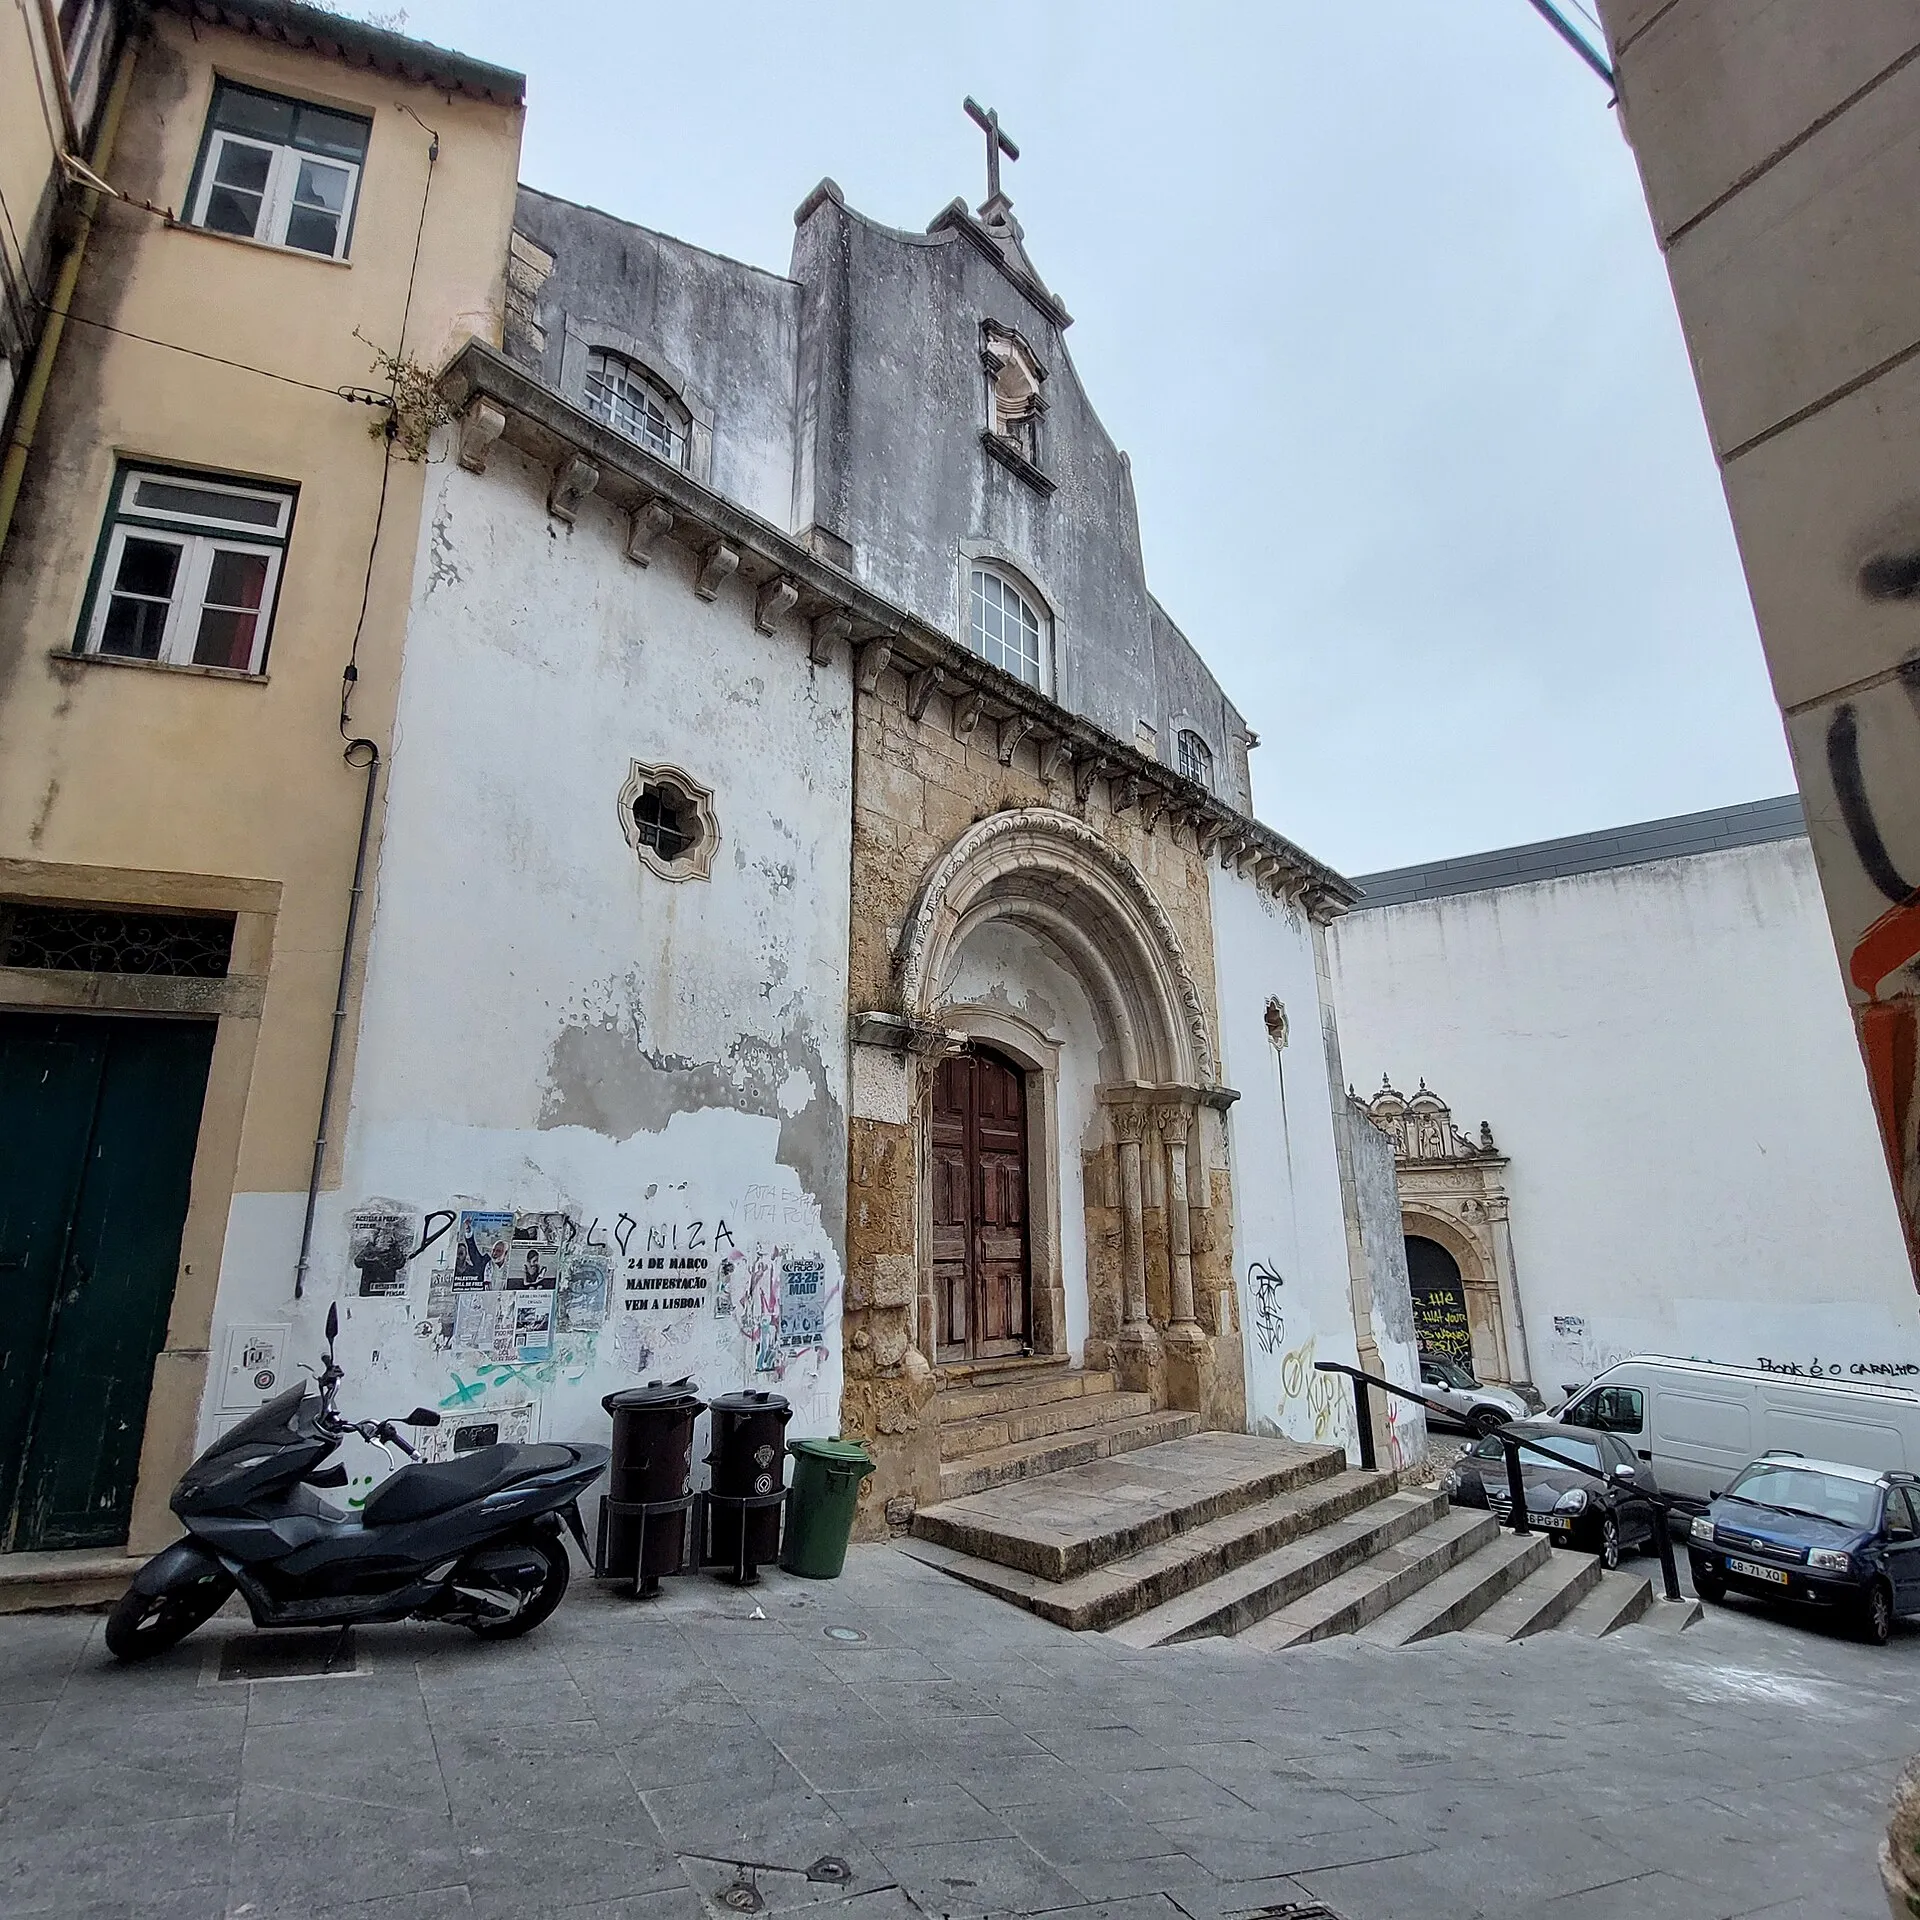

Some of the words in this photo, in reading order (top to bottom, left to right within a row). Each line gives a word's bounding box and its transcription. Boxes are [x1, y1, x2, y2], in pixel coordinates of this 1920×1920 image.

[627, 1258, 643, 1269] 24
[647, 1258, 664, 1269] DE
[669, 1257, 708, 1272] MARÇO
[788, 1272, 818, 1283] 23-26
[789, 1283, 816, 1295] MAIO
[625, 1299, 648, 1310] VEM
[651, 1299, 659, 1309] A
[662, 1297, 705, 1309] LISBOA!
